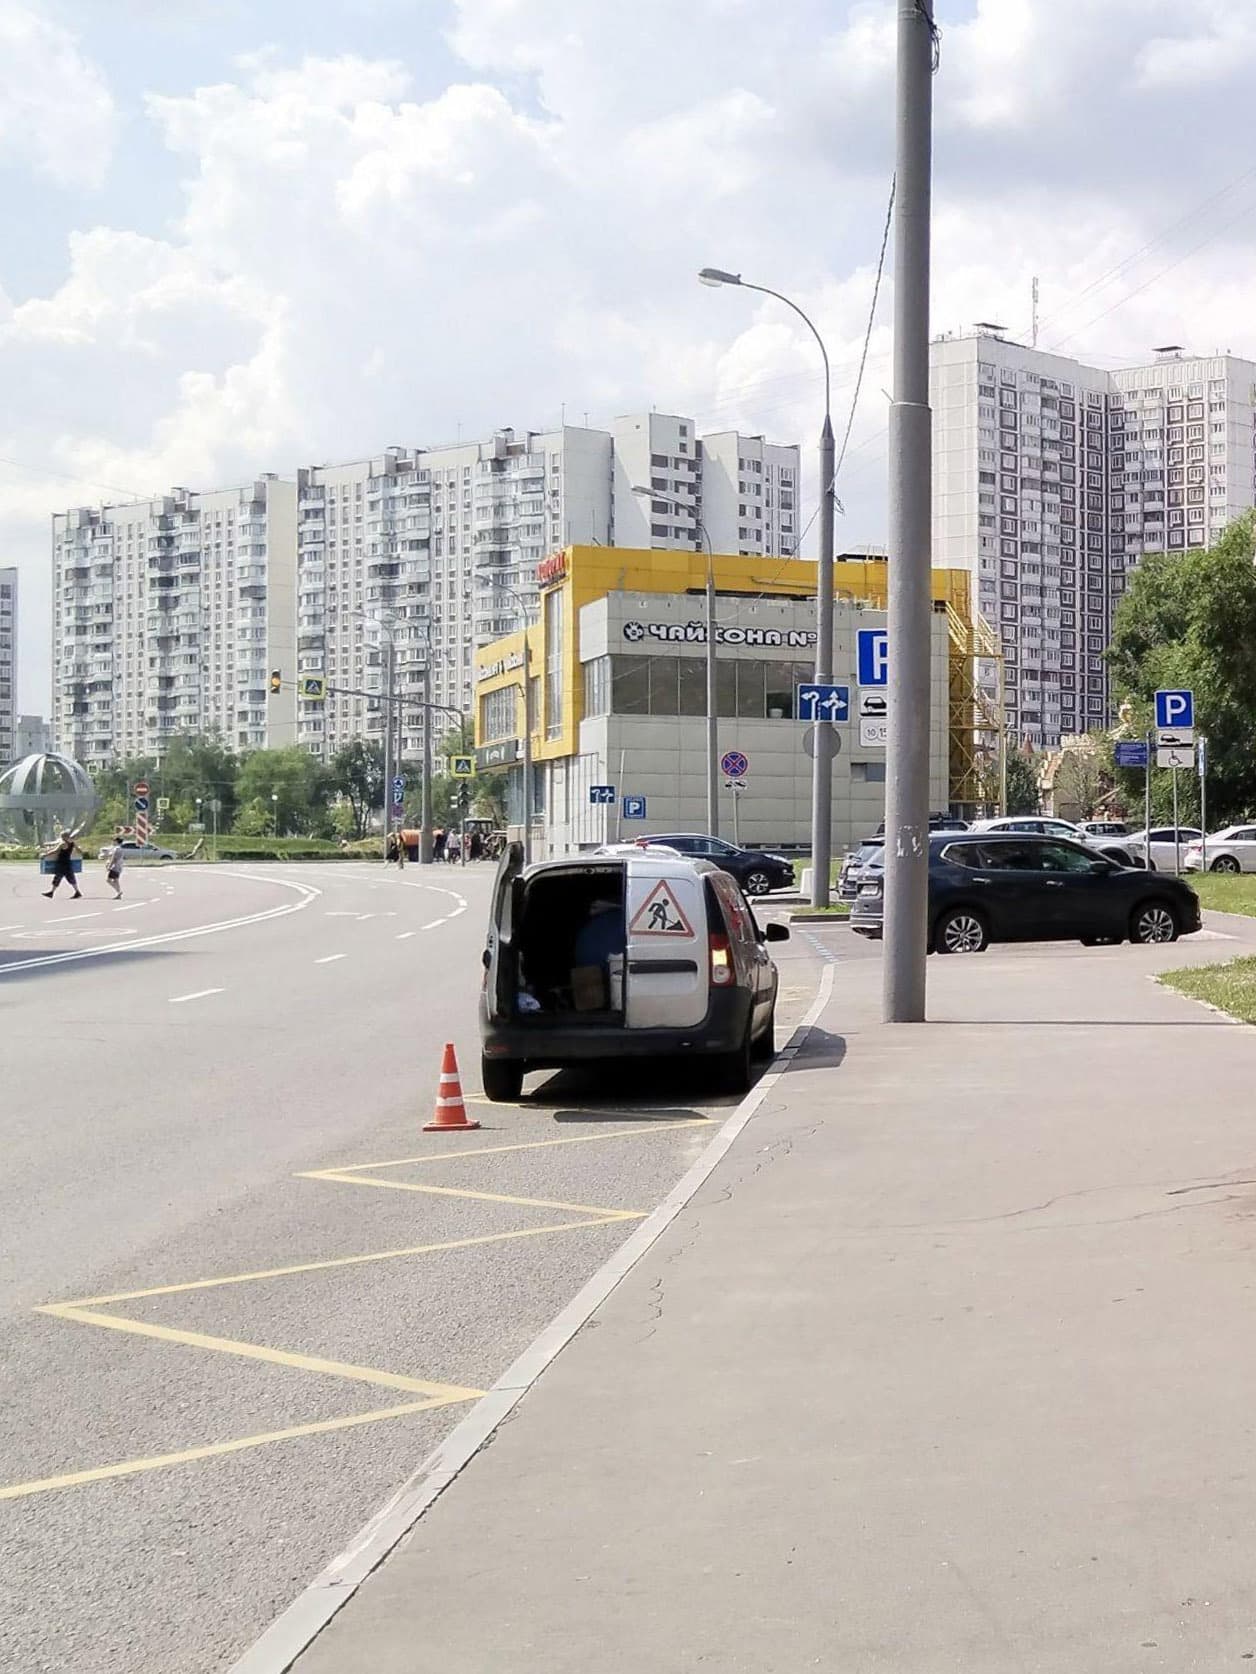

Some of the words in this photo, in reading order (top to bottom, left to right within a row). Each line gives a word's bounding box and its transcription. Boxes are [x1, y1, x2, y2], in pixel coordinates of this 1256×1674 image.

[649, 621, 782, 645] ЧАЙОНА
[1166, 695, 1187, 724] P
[629, 802, 640, 813] P
